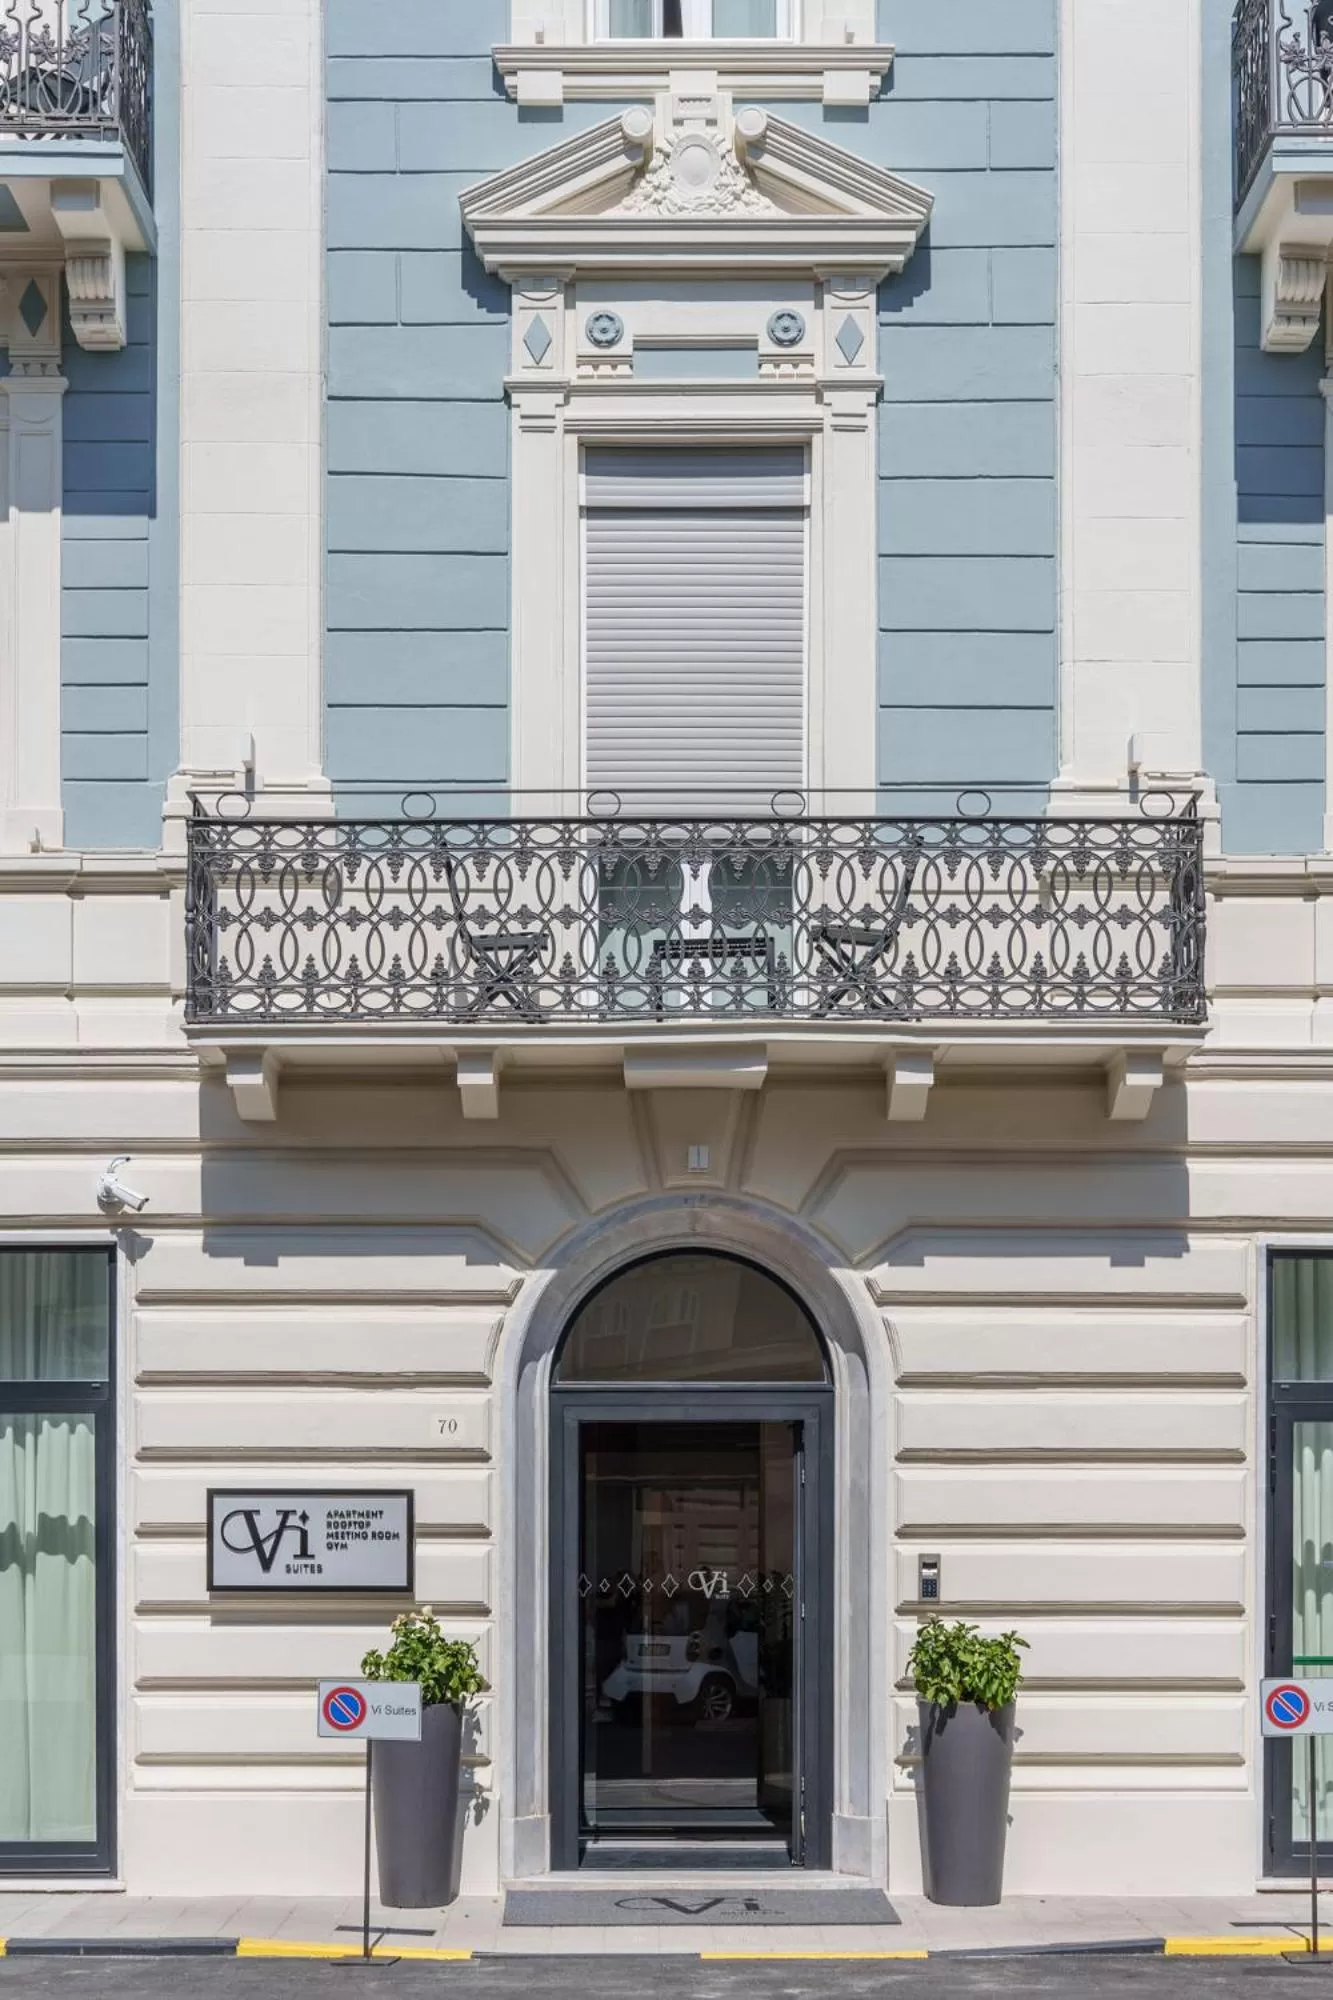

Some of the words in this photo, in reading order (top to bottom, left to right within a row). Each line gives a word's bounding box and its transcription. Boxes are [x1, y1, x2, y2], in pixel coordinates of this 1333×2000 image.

[438, 1419, 457, 1434] 70
[326, 1509, 384, 1520] APARTMENT
[326, 1520, 371, 1530] ROOFTOP
[221, 1509, 315, 1573] Vi
[326, 1530, 368, 1541] MEETING
[371, 1530, 400, 1541] ROOM
[285, 1563, 323, 1574] SUITES
[371, 1705, 382, 1716] Vi
[384, 1704, 417, 1716] Suites
[1313, 1702, 1325, 1712] Vi
